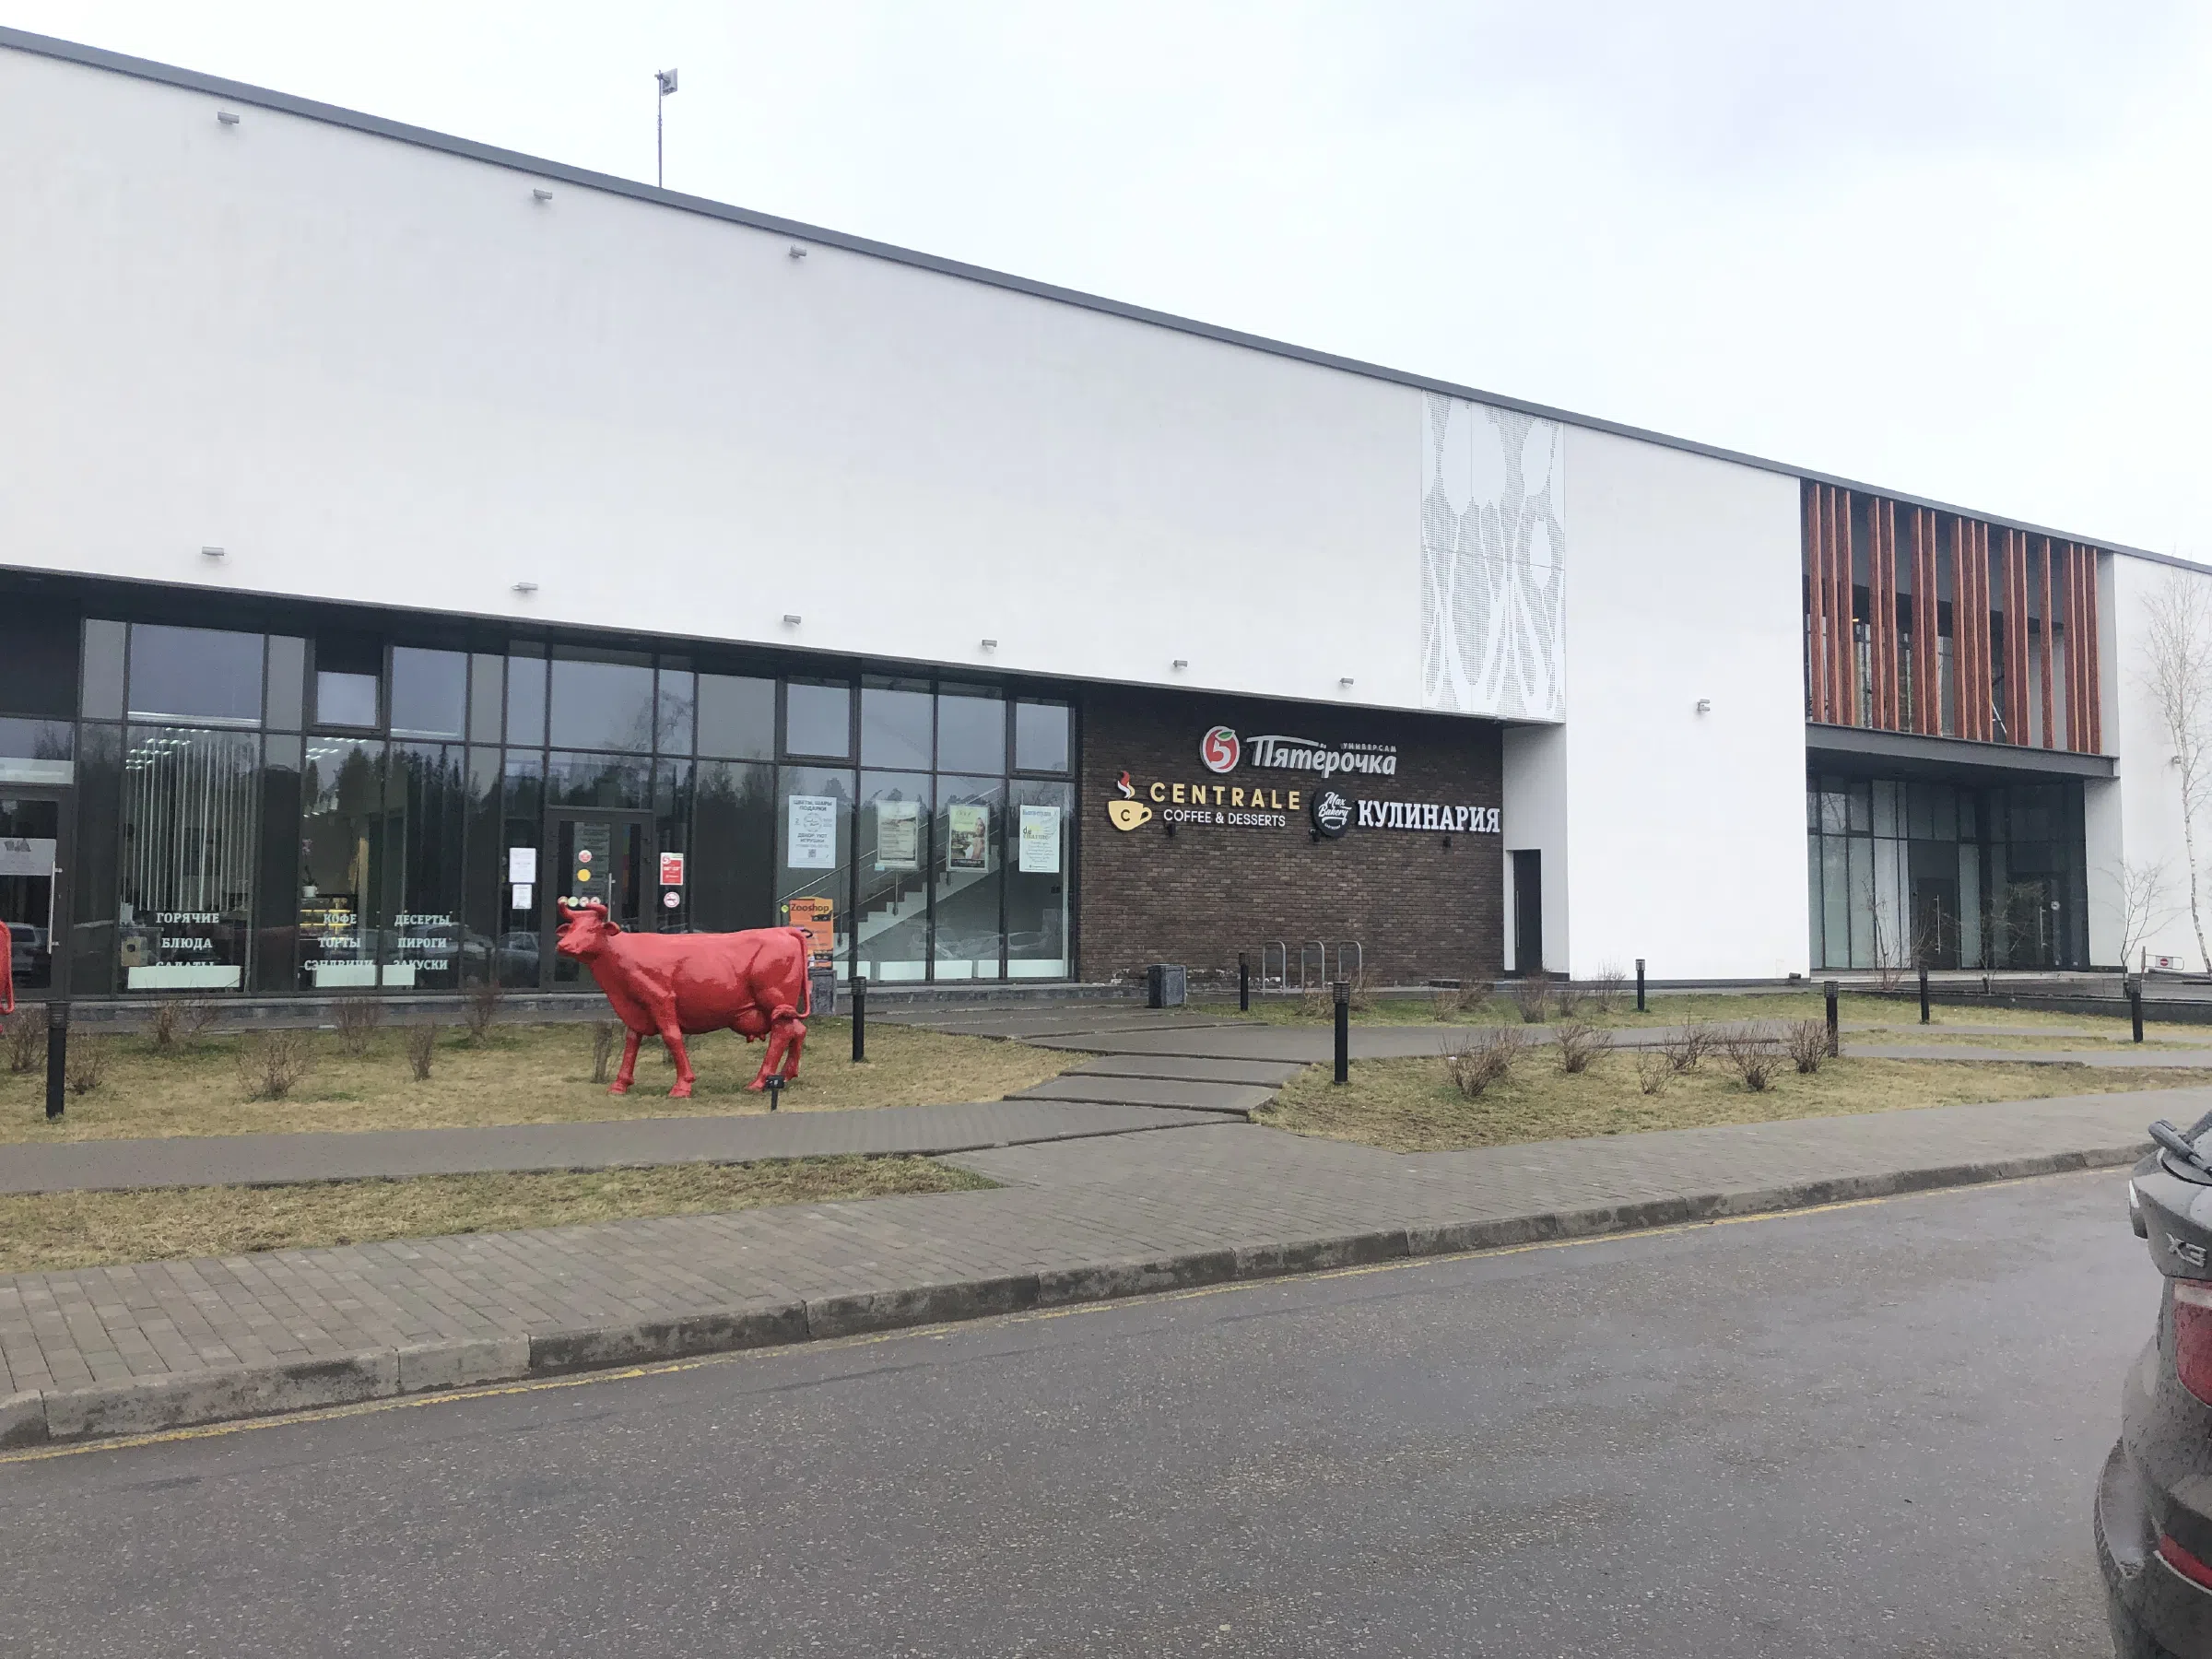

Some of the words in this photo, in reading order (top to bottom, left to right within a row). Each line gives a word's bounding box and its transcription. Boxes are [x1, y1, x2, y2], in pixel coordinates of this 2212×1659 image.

[1342, 742, 1396, 753] УНИВЕРСАМ
[1150, 782, 1300, 810] CENTRALE
[1324, 791, 1347, 808] Max
[1120, 808, 1131, 822] C
[1163, 808, 1211, 824] COFFEE
[1215, 811, 1224, 825] &
[1228, 812, 1286, 827] DESSERTS
[1318, 802, 1349, 825] Bakery
[1358, 799, 1500, 833] КУЛИНАРИЯ
[790, 903, 830, 913] Zooshop
[156, 912, 219, 924] ГОРЯЧИЕ
[323, 913, 357, 924] КОФЕ
[394, 914, 451, 927] ДЕСЕРТЫ
[161, 937, 213, 950] БЛЮДА
[317, 937, 361, 948] ТОРТЫ
[397, 937, 447, 948] ПИРОГИ
[2165, 1232, 2206, 1267] X3
